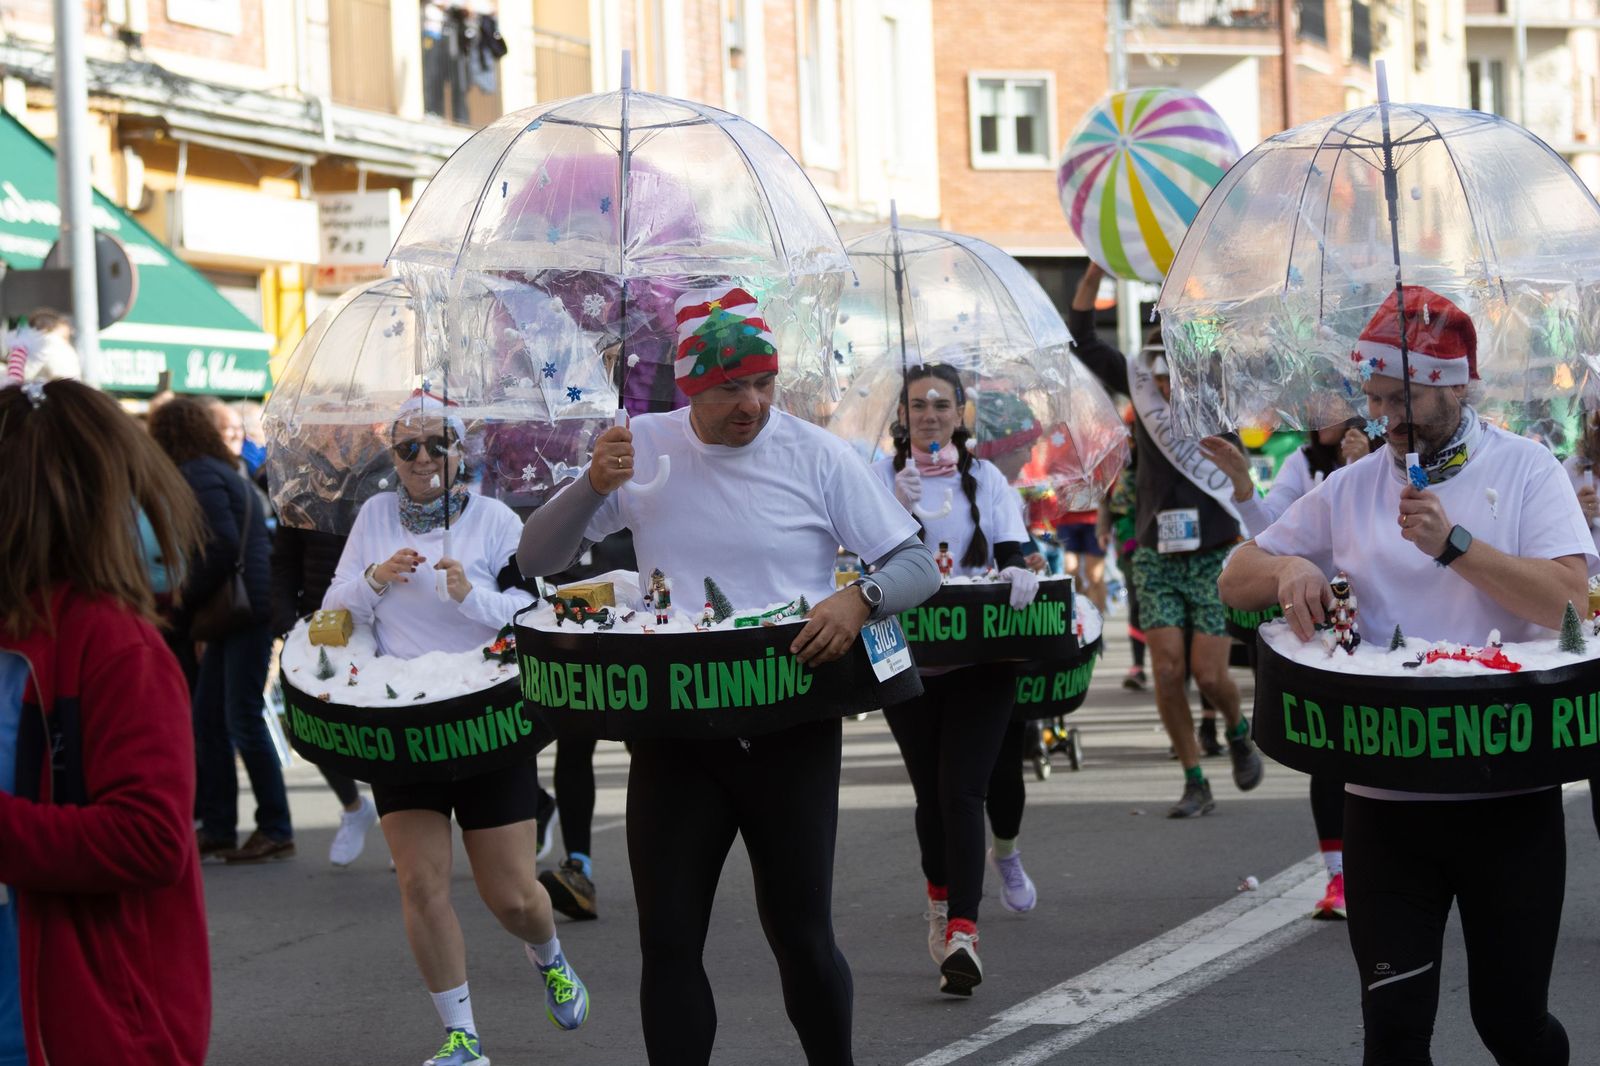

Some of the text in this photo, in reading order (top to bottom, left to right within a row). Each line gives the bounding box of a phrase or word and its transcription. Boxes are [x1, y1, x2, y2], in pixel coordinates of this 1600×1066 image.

[870, 619, 898, 655] 3103
[897, 606, 967, 641] ENGO
[523, 655, 648, 711] ABADENGO
[291, 704, 395, 761] ABADENGO
[1282, 691, 1600, 759] C.D. ABADENGO RU
